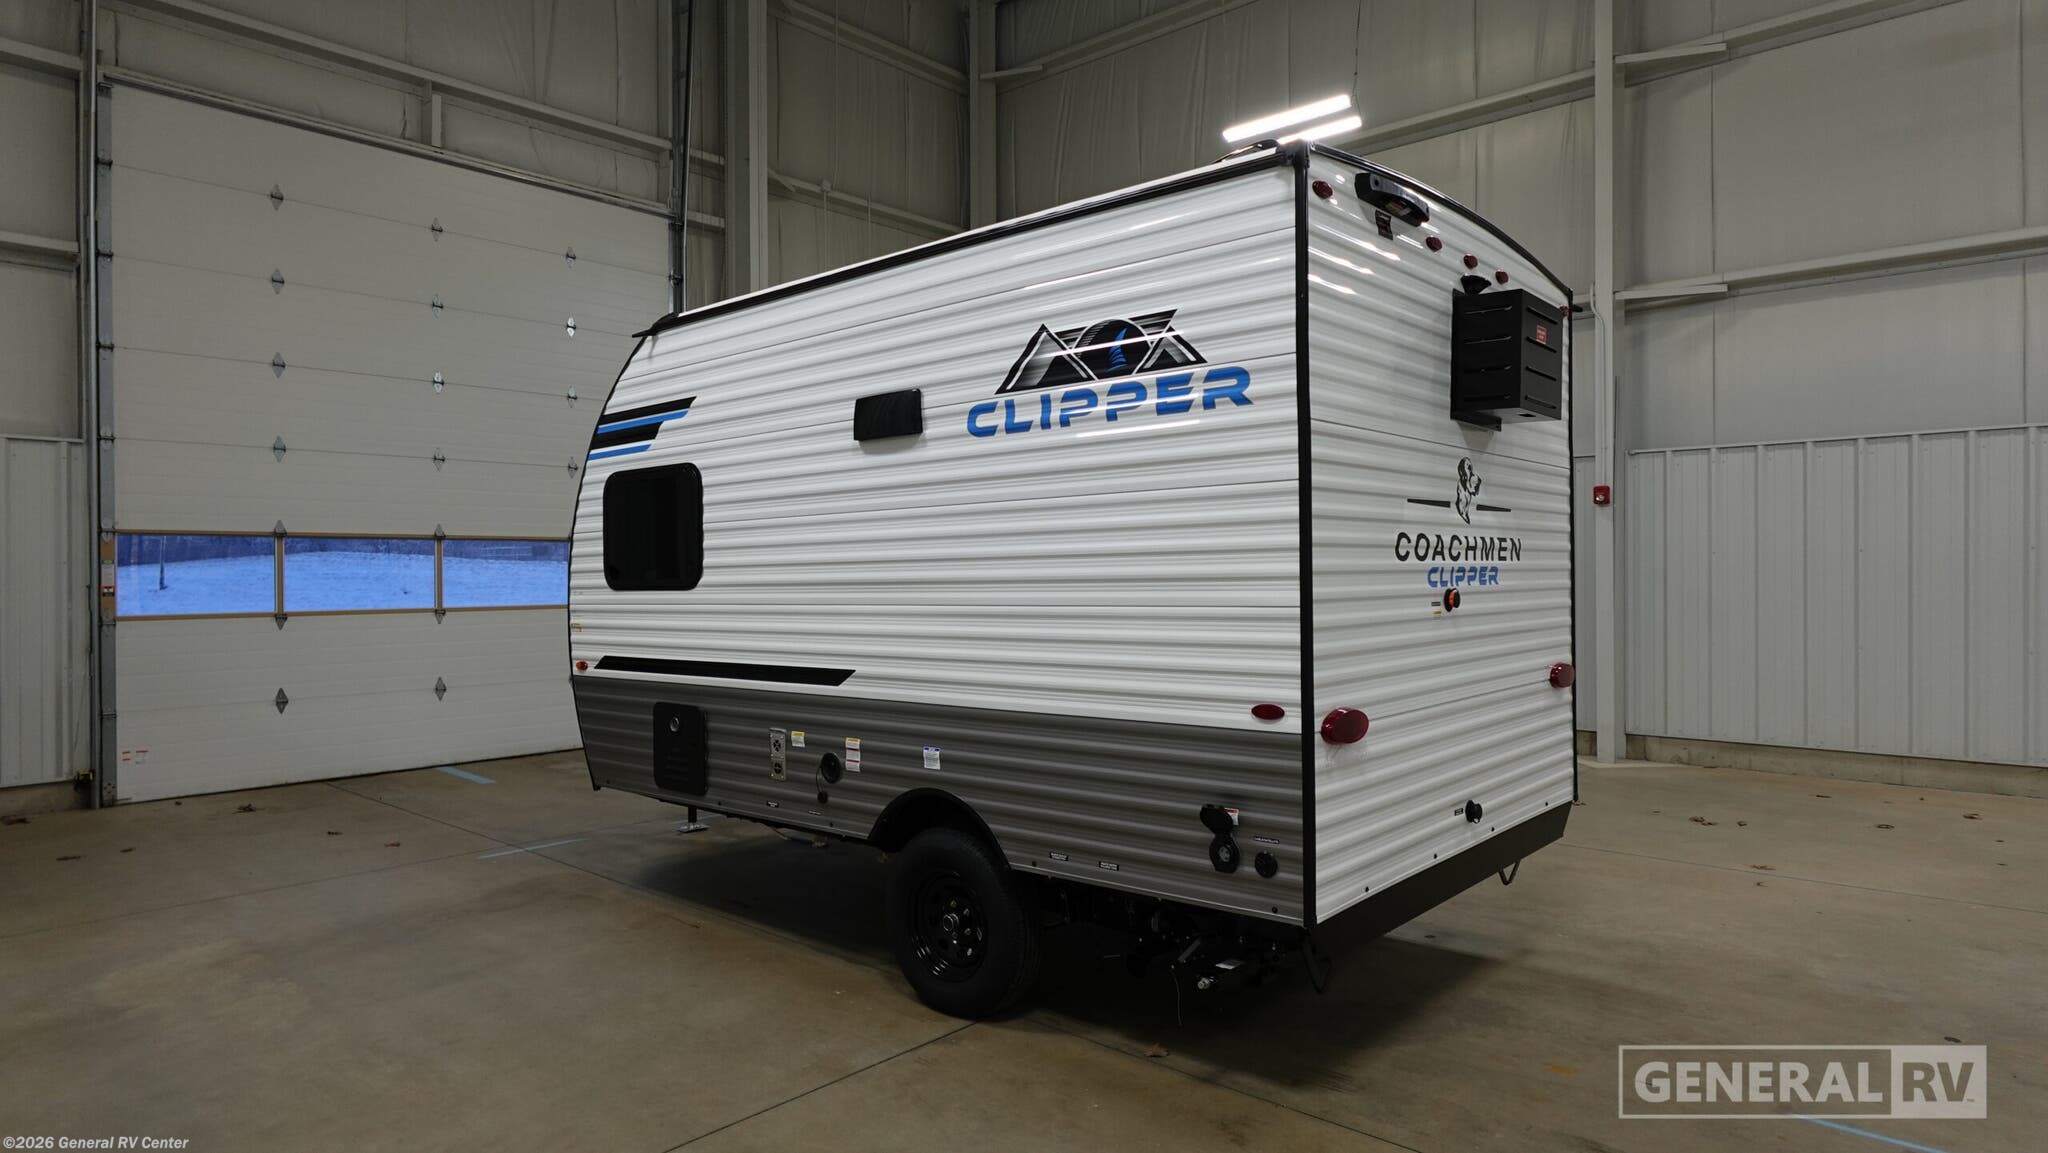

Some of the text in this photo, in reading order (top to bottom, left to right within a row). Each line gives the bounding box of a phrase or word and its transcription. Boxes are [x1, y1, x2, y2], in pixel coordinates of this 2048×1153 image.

[967, 366, 1253, 437] CLIPPER
[1395, 532, 1521, 562] COACHMEN
[1427, 566, 1499, 588] CLIPPER
